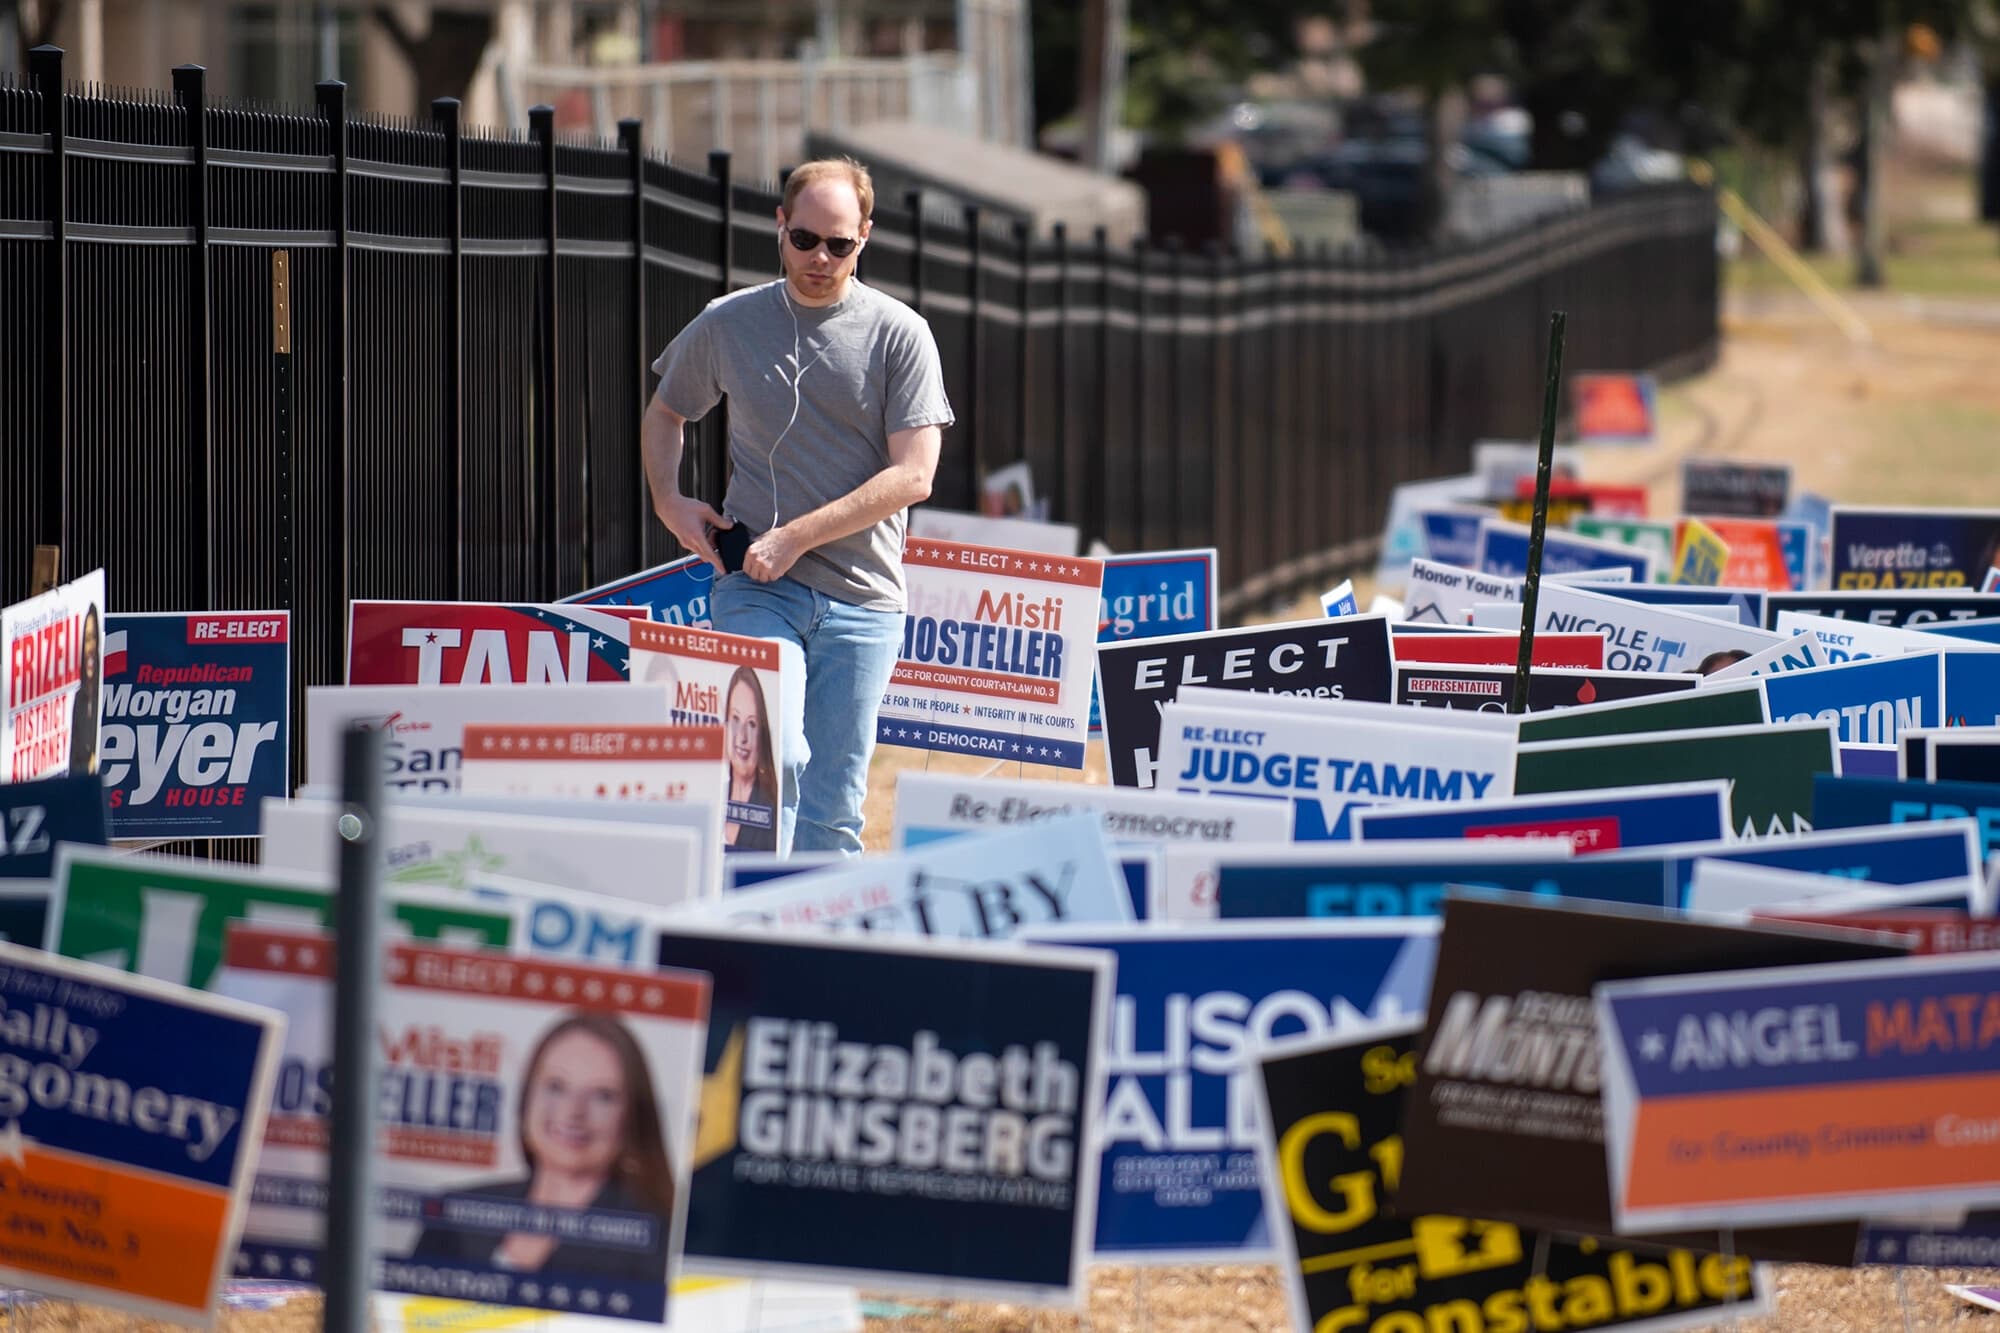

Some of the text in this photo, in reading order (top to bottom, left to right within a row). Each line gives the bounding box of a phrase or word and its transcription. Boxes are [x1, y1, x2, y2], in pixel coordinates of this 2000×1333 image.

[960, 550, 1009, 569] ELECT
[1848, 543, 1928, 569] Veretta
[1413, 564, 1462, 588] Honor
[1466, 575, 1502, 598] Your
[975, 589, 1064, 631] Misti
[1101, 580, 1196, 635] grid
[194, 620, 282, 640] RE-ELECT
[686, 634, 719, 654] ELECT
[1545, 611, 1648, 651] NICOLE
[10, 615, 81, 709] FRIZELL
[137, 664, 253, 686] Republican
[1134, 637, 1349, 691] ELECT
[676, 681, 718, 714] Misti
[895, 669, 914, 681] DGE
[914, 670, 932, 682] FOR
[933, 672, 970, 687] COUNTY
[1033, 687, 1048, 697] NO.
[1048, 688, 1055, 697] 3
[1410, 679, 1500, 695] REPRESENTATIVE
[15, 693, 68, 747] DISTRICT
[102, 684, 236, 723] Morgan
[893, 695, 910, 708] FOR
[912, 697, 927, 710] THE
[929, 700, 960, 714] PEOPLE
[974, 705, 1017, 721] INTEGRITY
[1018, 711, 1027, 723] IN
[1029, 713, 1043, 725] THE
[1045, 715, 1076, 729] COURTS
[569, 732, 626, 755] ELECT
[928, 730, 1006, 752] DEMOCRAT
[1182, 726, 1265, 747] RE-ELECT
[12, 730, 68, 785] ATTORNEY
[102, 720, 278, 806] eyer
[1179, 748, 1320, 790] JUDGE
[1327, 760, 1495, 801] TAMMY
[165, 787, 246, 808] HOUSE
[1105, 811, 1235, 842] emocrat
[0, 1001, 99, 1069] ally
[1670, 1003, 1859, 1073] ANGEL
[742, 1016, 1080, 1115] Elizabeth
[0, 1052, 240, 1163] gomery
[740, 1094, 1077, 1180] GINSBERG
[1934, 1115, 2000, 1148] Cour
[1347, 1262, 1419, 1306] for
